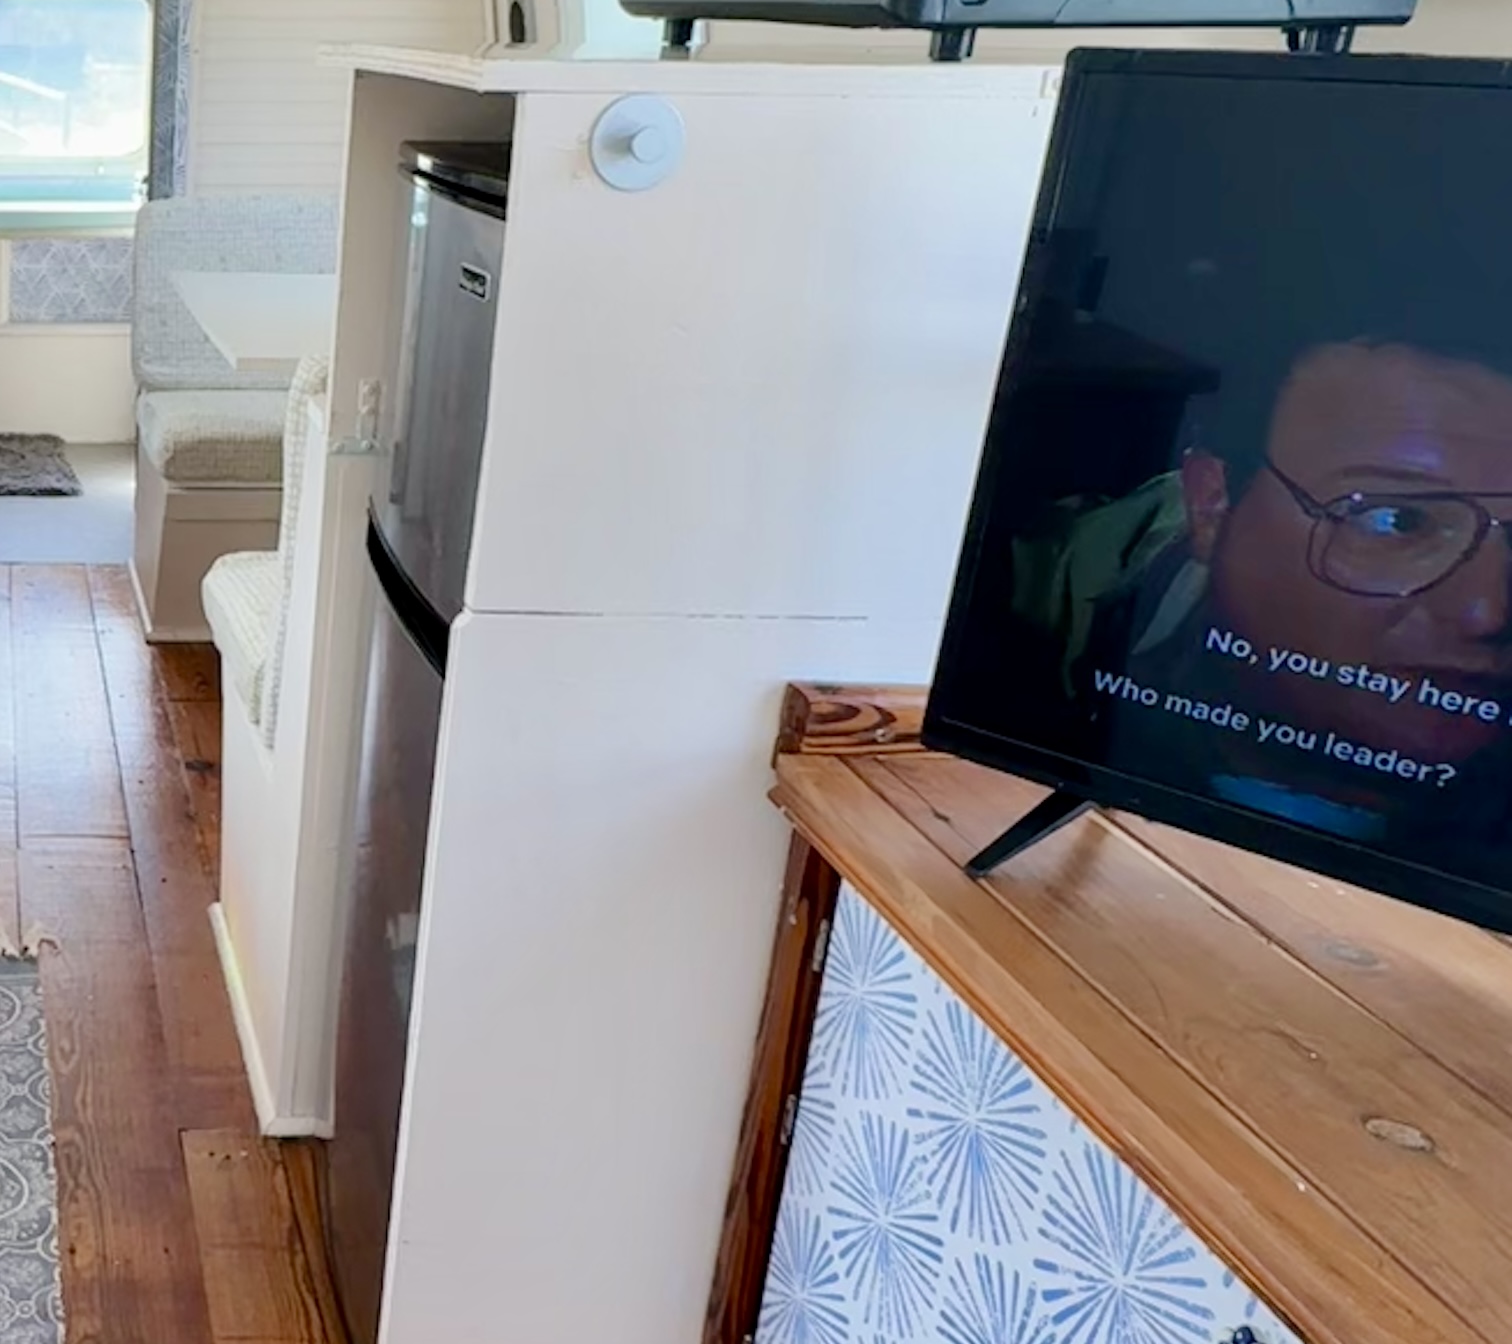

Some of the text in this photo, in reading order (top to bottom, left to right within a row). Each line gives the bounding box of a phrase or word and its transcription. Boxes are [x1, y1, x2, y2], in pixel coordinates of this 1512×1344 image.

[1205, 628, 1500, 721] No, you stay here
[1094, 670, 1456, 787] Who made you leader?
